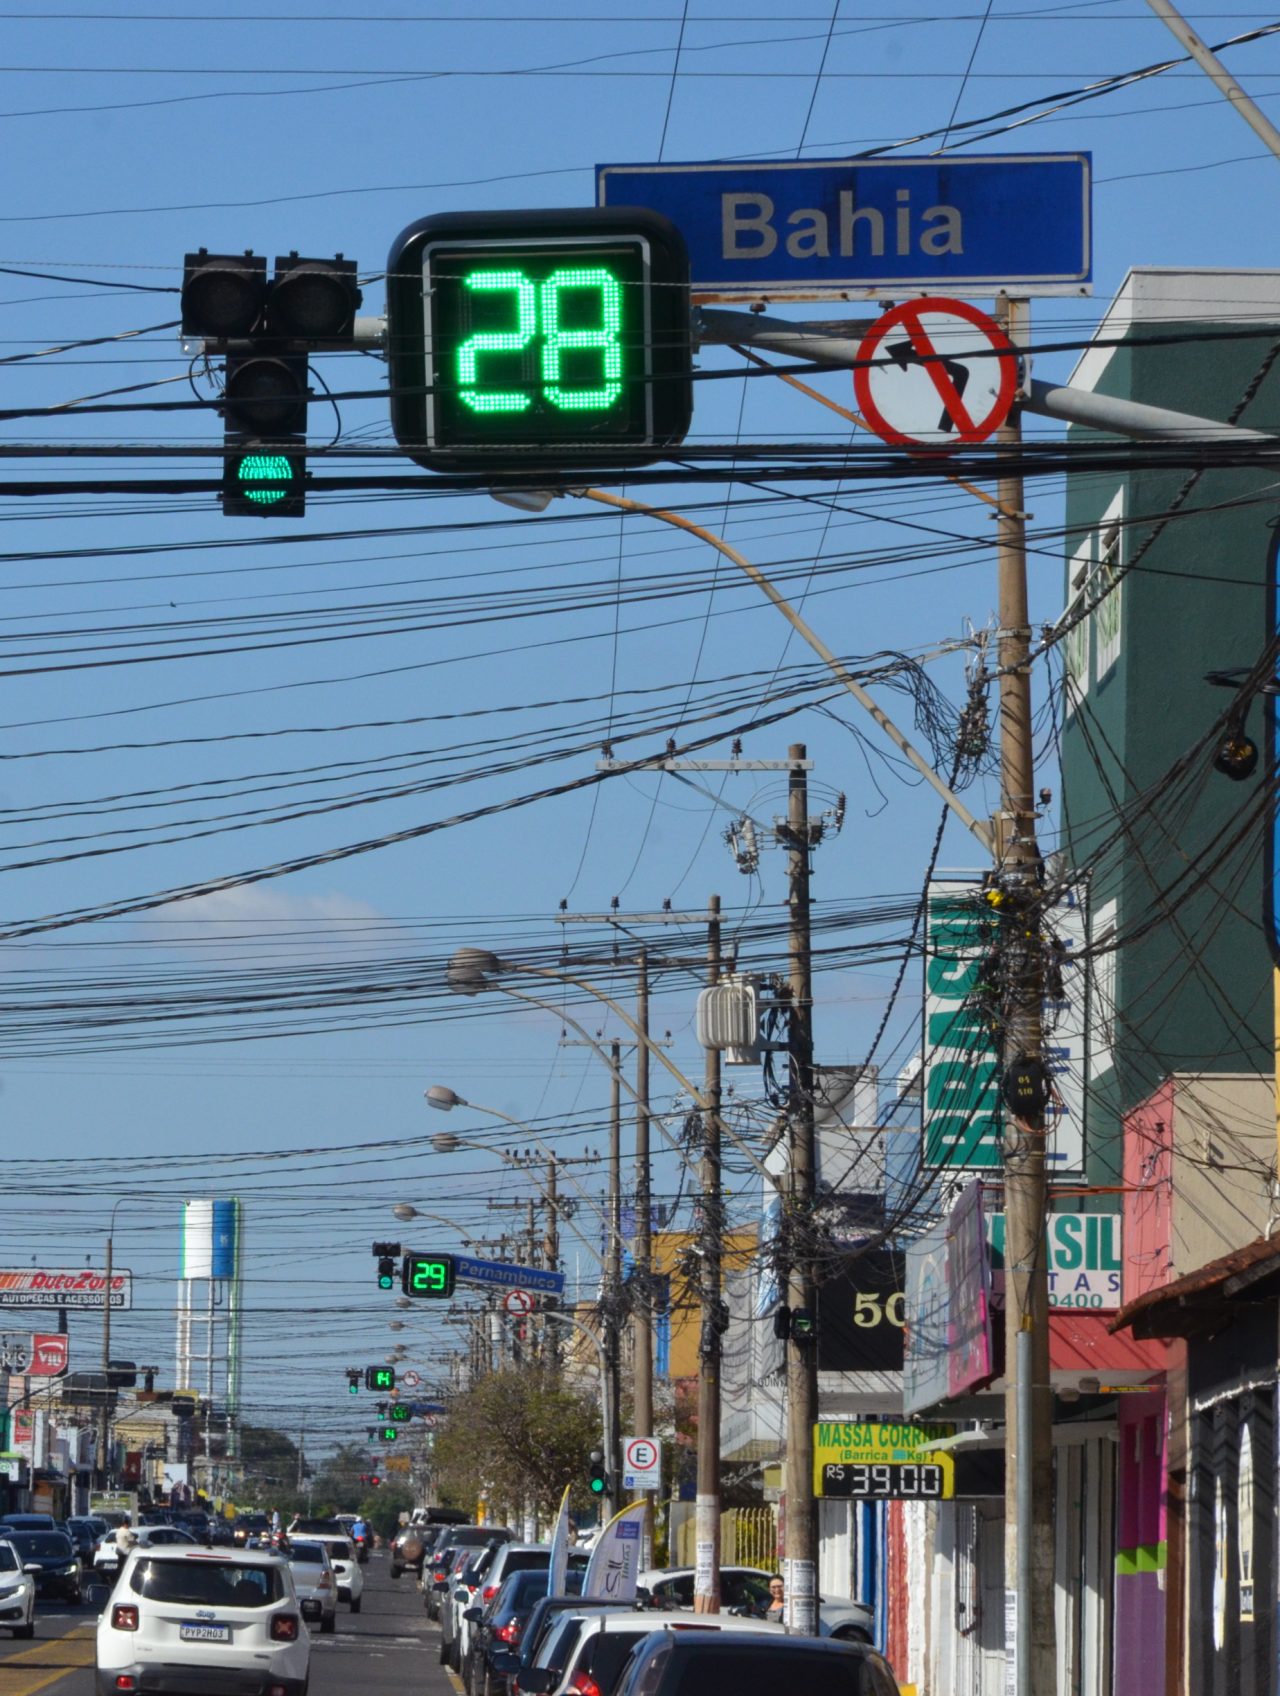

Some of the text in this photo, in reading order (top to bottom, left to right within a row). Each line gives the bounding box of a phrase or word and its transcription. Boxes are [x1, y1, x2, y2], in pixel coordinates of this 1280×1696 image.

[721, 189, 965, 261] Bahia
[458, 267, 621, 412] 28
[30, 1272, 124, 1290] AutoZone
[413, 1262, 445, 1290] 29
[459, 1261, 556, 1289] Pernambuco
[2, 1292, 122, 1305] AUTOPEÇAS E ACESSÓROS
[819, 1423, 873, 1447] MASSA
[636, 1447, 648, 1463] E
[840, 1450, 888, 1462] (Barrica
[826, 1464, 845, 1480] R$
